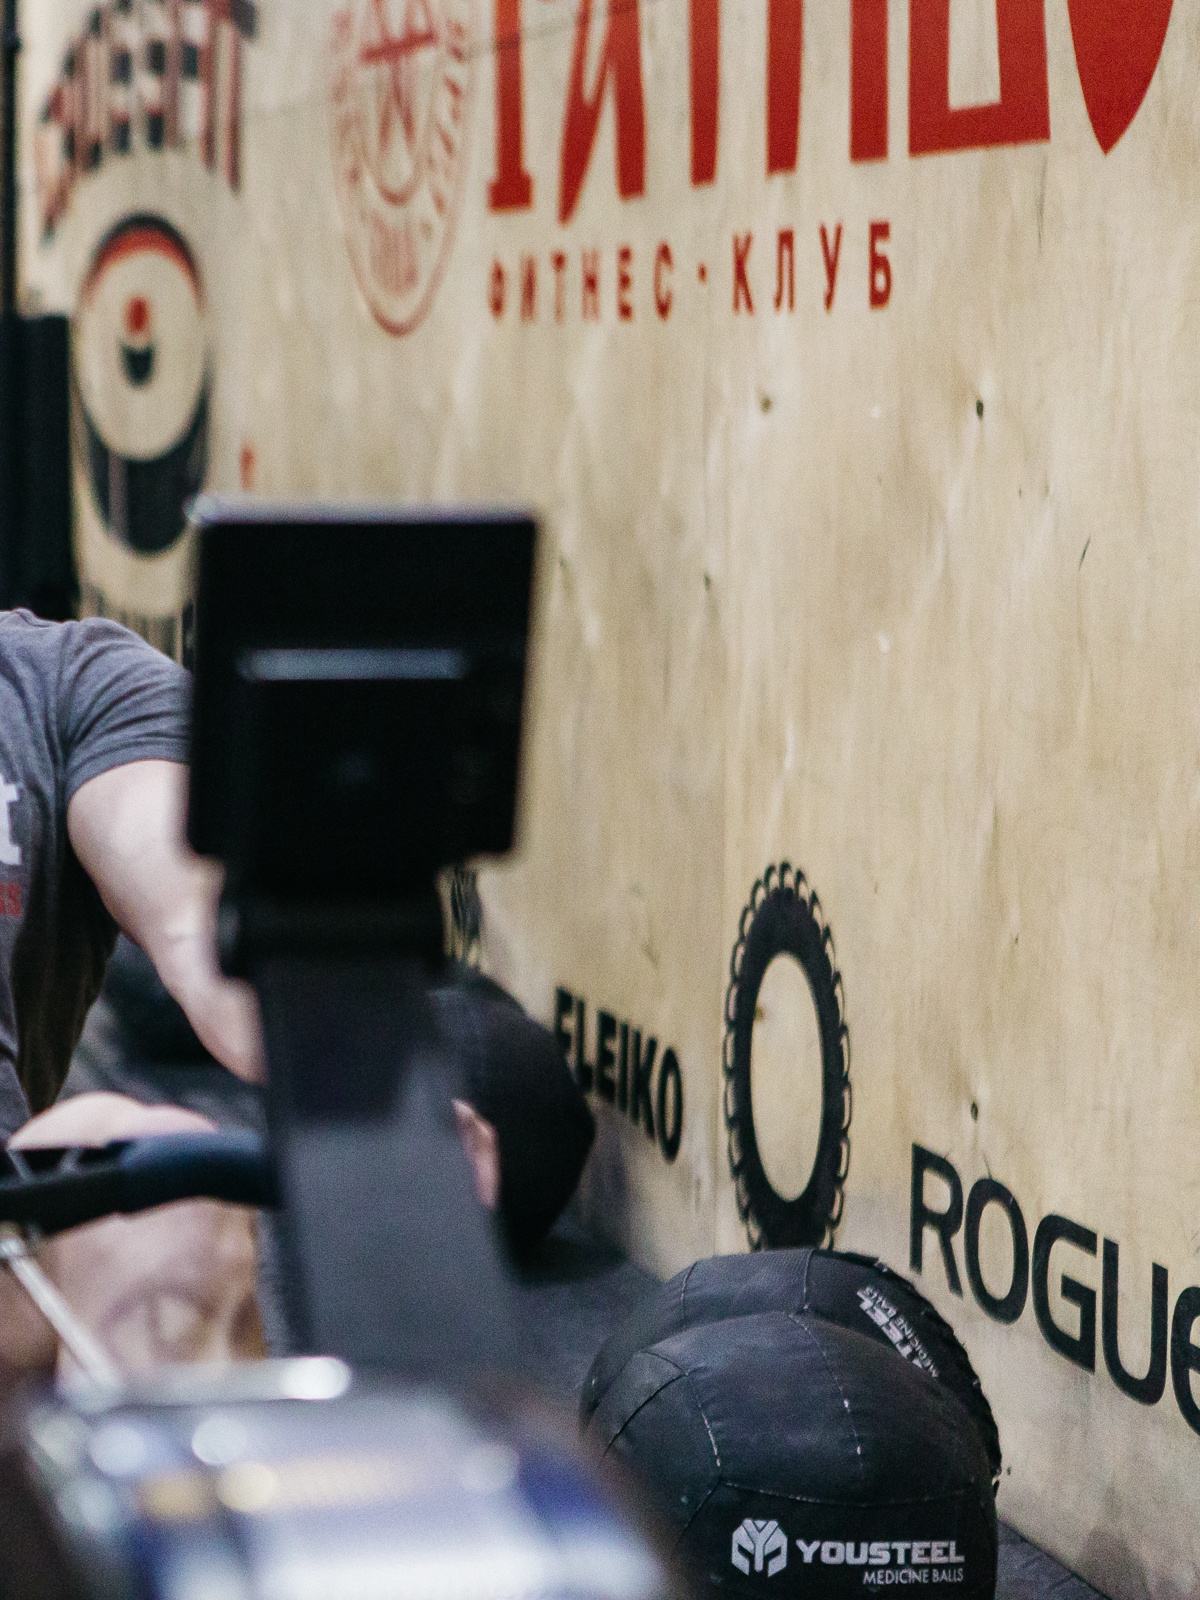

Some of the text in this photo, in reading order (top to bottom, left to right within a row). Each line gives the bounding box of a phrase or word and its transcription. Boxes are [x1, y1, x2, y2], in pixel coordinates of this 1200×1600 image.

[796, 1539, 965, 1565] YOUSTEEL
[863, 1567, 965, 1584] MEDICINE BALLS
